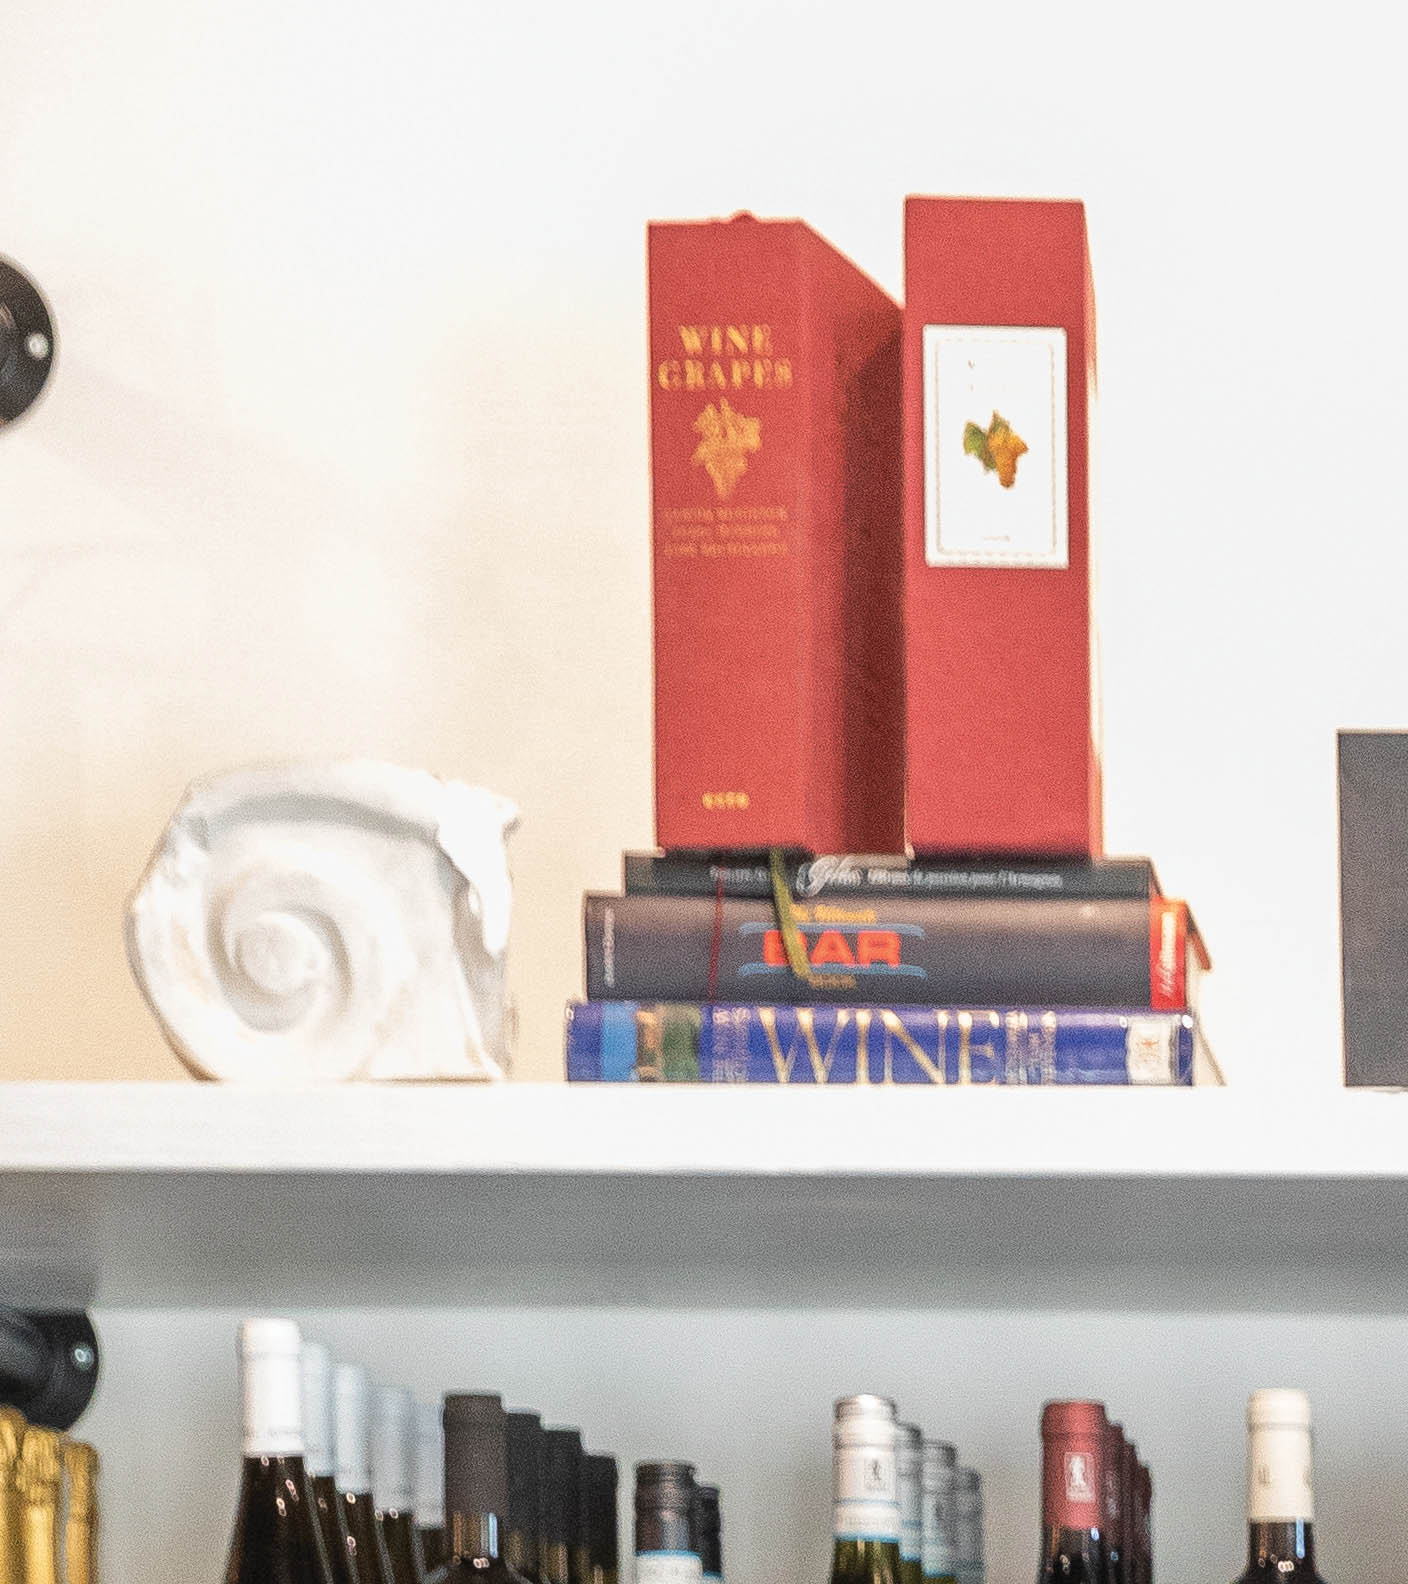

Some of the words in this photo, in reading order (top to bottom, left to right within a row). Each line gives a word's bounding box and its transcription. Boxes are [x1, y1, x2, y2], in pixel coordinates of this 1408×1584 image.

[678, 323, 774, 355] WINE
[657, 359, 794, 391] GRAPES
[763, 929, 903, 968] BAR
[760, 1006, 1000, 1084] WINE
